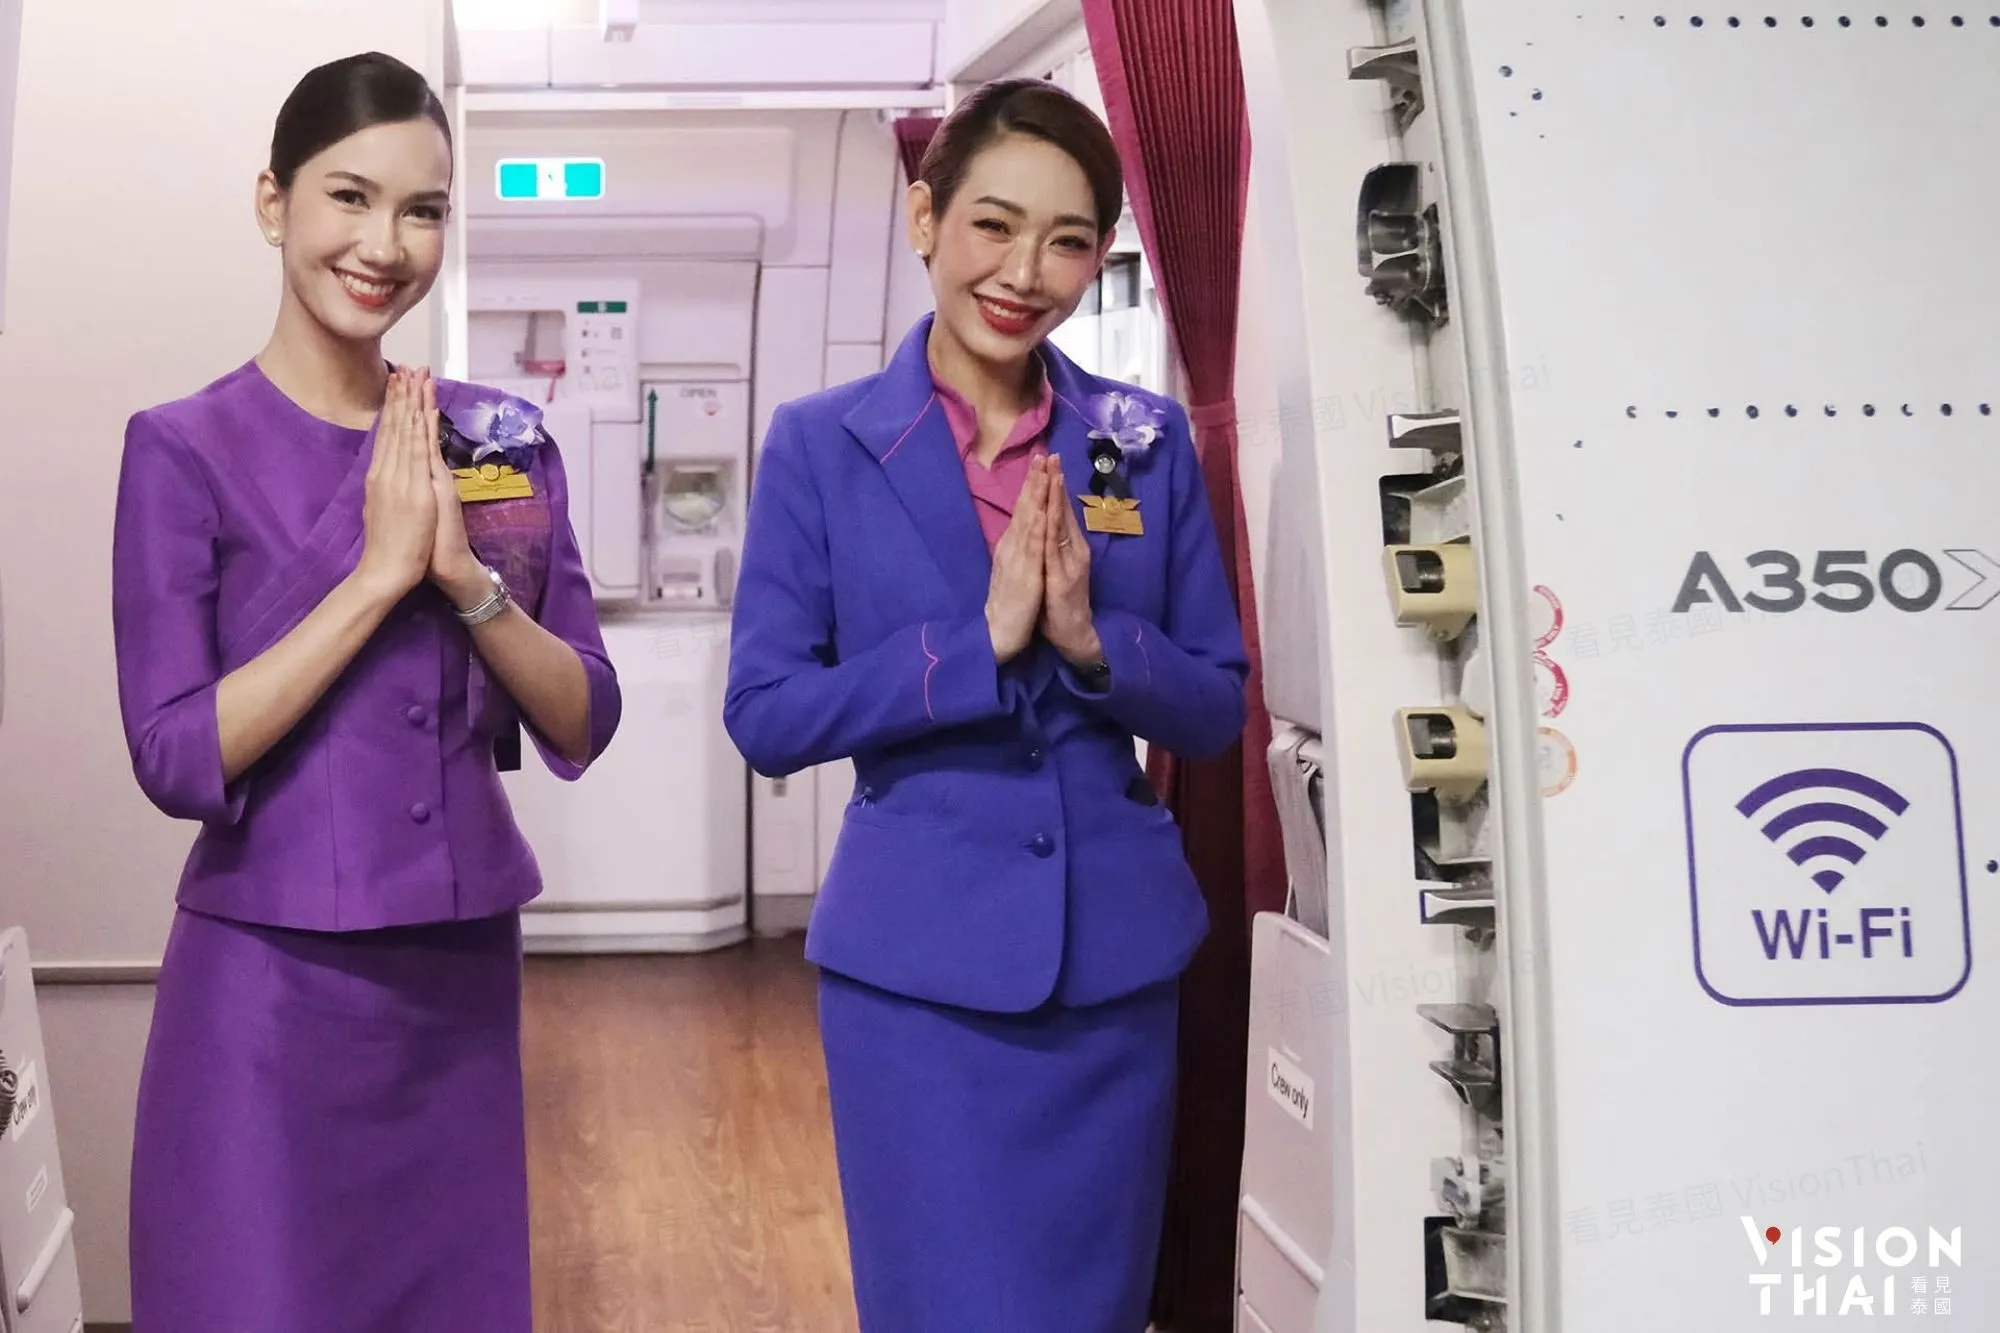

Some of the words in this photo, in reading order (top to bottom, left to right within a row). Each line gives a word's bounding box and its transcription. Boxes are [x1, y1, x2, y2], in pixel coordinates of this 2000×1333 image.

[1672, 548, 1942, 613] A350
[1751, 907, 1913, 960] Wi-Fi
[1271, 1062, 1292, 1100] Crew
[1292, 1085, 1309, 1119] only
